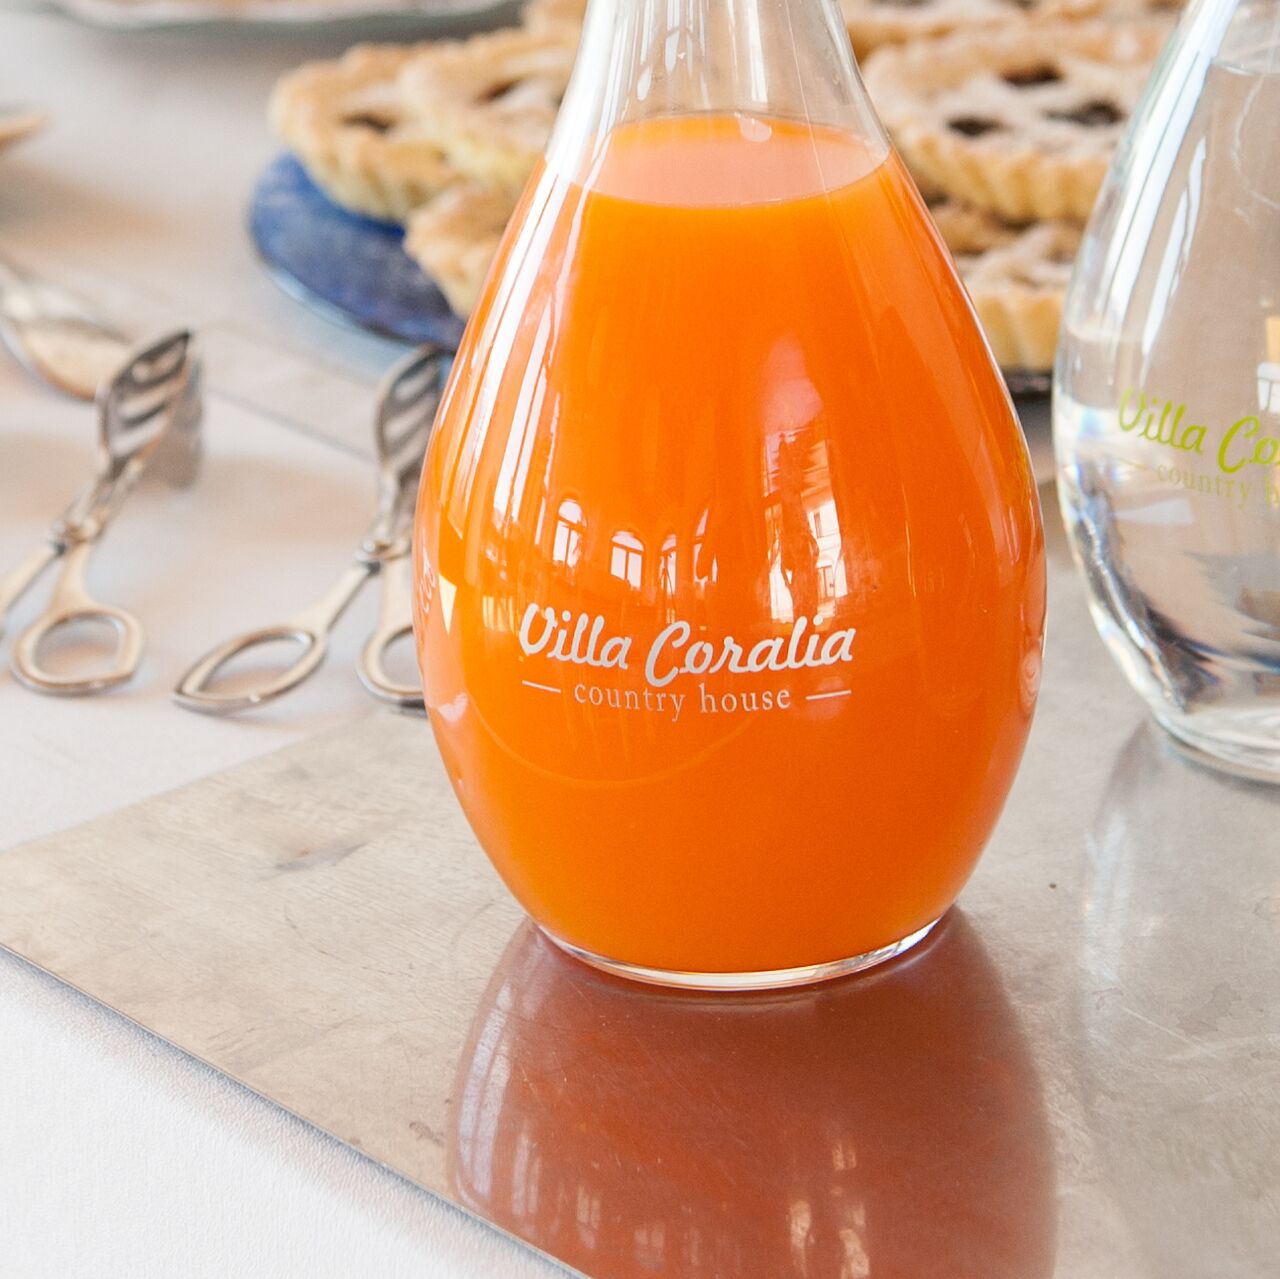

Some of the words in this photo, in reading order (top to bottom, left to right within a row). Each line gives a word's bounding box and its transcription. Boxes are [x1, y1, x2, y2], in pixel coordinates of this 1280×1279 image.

[1120, 387, 1207, 454] Villa
[1157, 464, 1253, 509] country
[520, 602, 632, 670] Villa
[644, 615, 857, 687] Coralia
[574, 681, 685, 723] country
[699, 682, 791, 713] house
